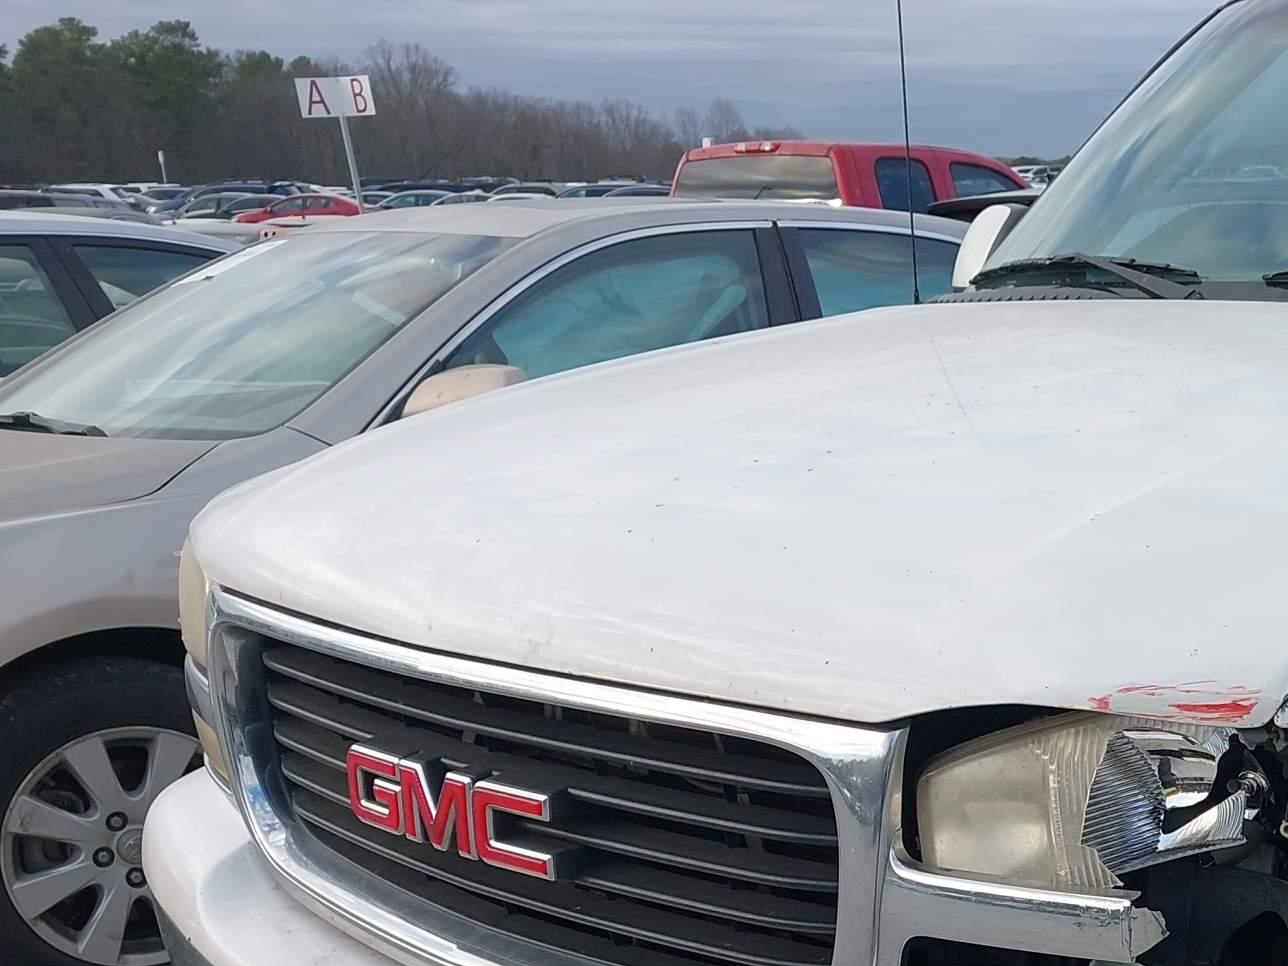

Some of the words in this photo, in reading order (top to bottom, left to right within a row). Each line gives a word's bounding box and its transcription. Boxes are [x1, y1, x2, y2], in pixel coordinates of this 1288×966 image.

[307, 79, 332, 116] A
[349, 77, 368, 114] B
[346, 743, 556, 882] GMC
